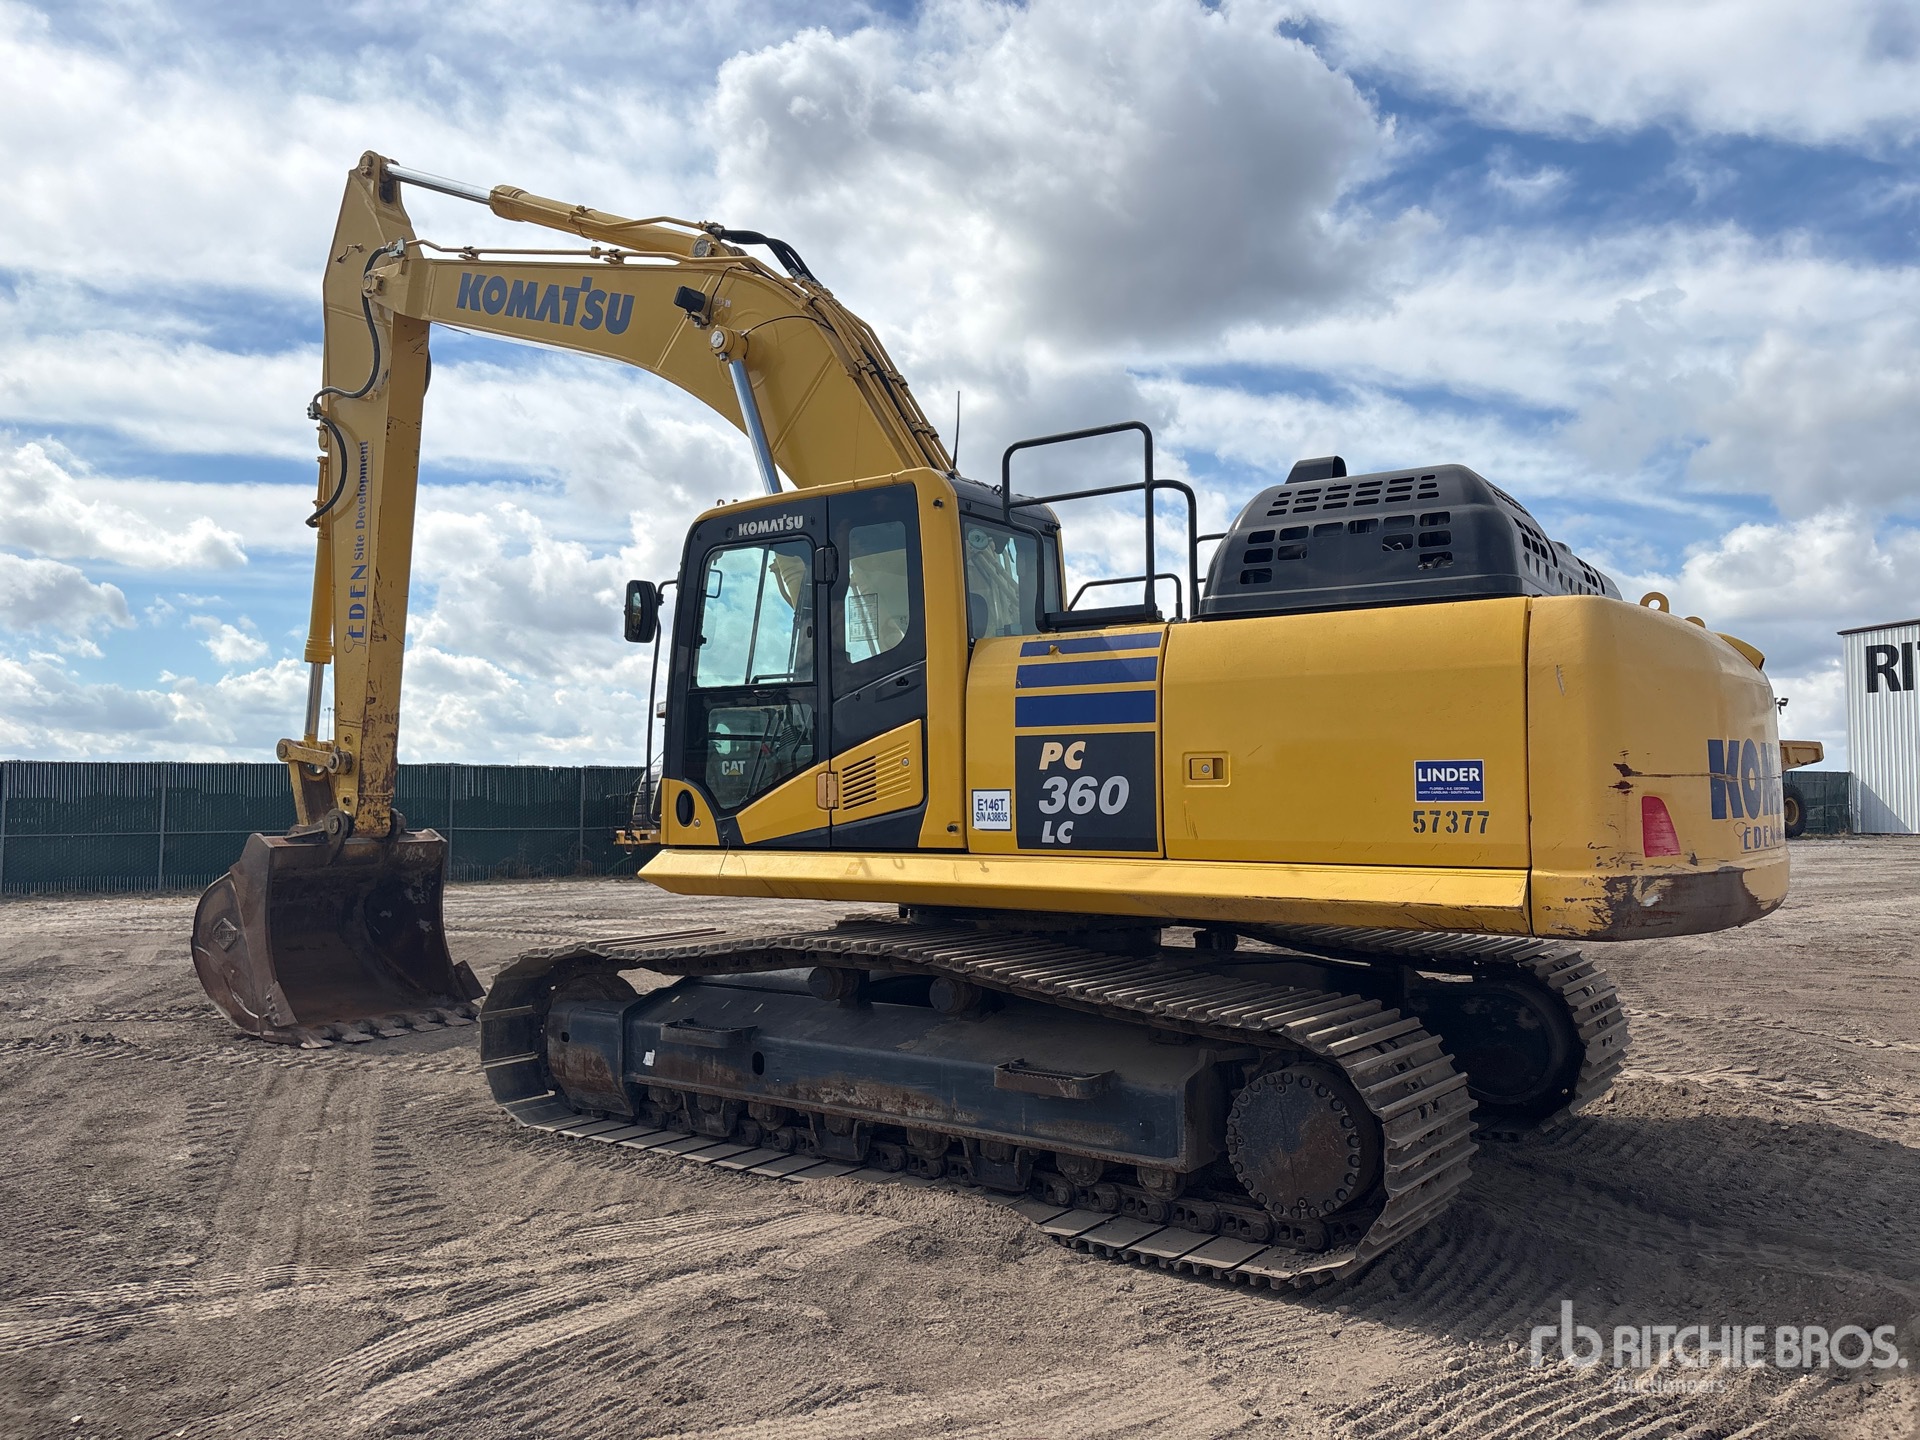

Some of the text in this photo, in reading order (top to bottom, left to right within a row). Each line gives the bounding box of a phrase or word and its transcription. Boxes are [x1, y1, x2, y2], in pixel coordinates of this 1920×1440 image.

[456, 272, 635, 335] KOMATSU
[738, 513, 804, 537] KOMATSU
[348, 440, 370, 639] EDEN Site Development
[1865, 640, 1920, 693] RI
[1038, 740, 1087, 771] PC
[721, 760, 746, 776] CAT
[1417, 767, 1481, 782] LINDER
[977, 798, 1006, 812] E146T
[1038, 775, 1130, 815] 360
[975, 811, 986, 822] S/N
[1412, 810, 1490, 834] 57377
[1041, 820, 1074, 844] LC
[1743, 825, 1776, 850] EDEN
